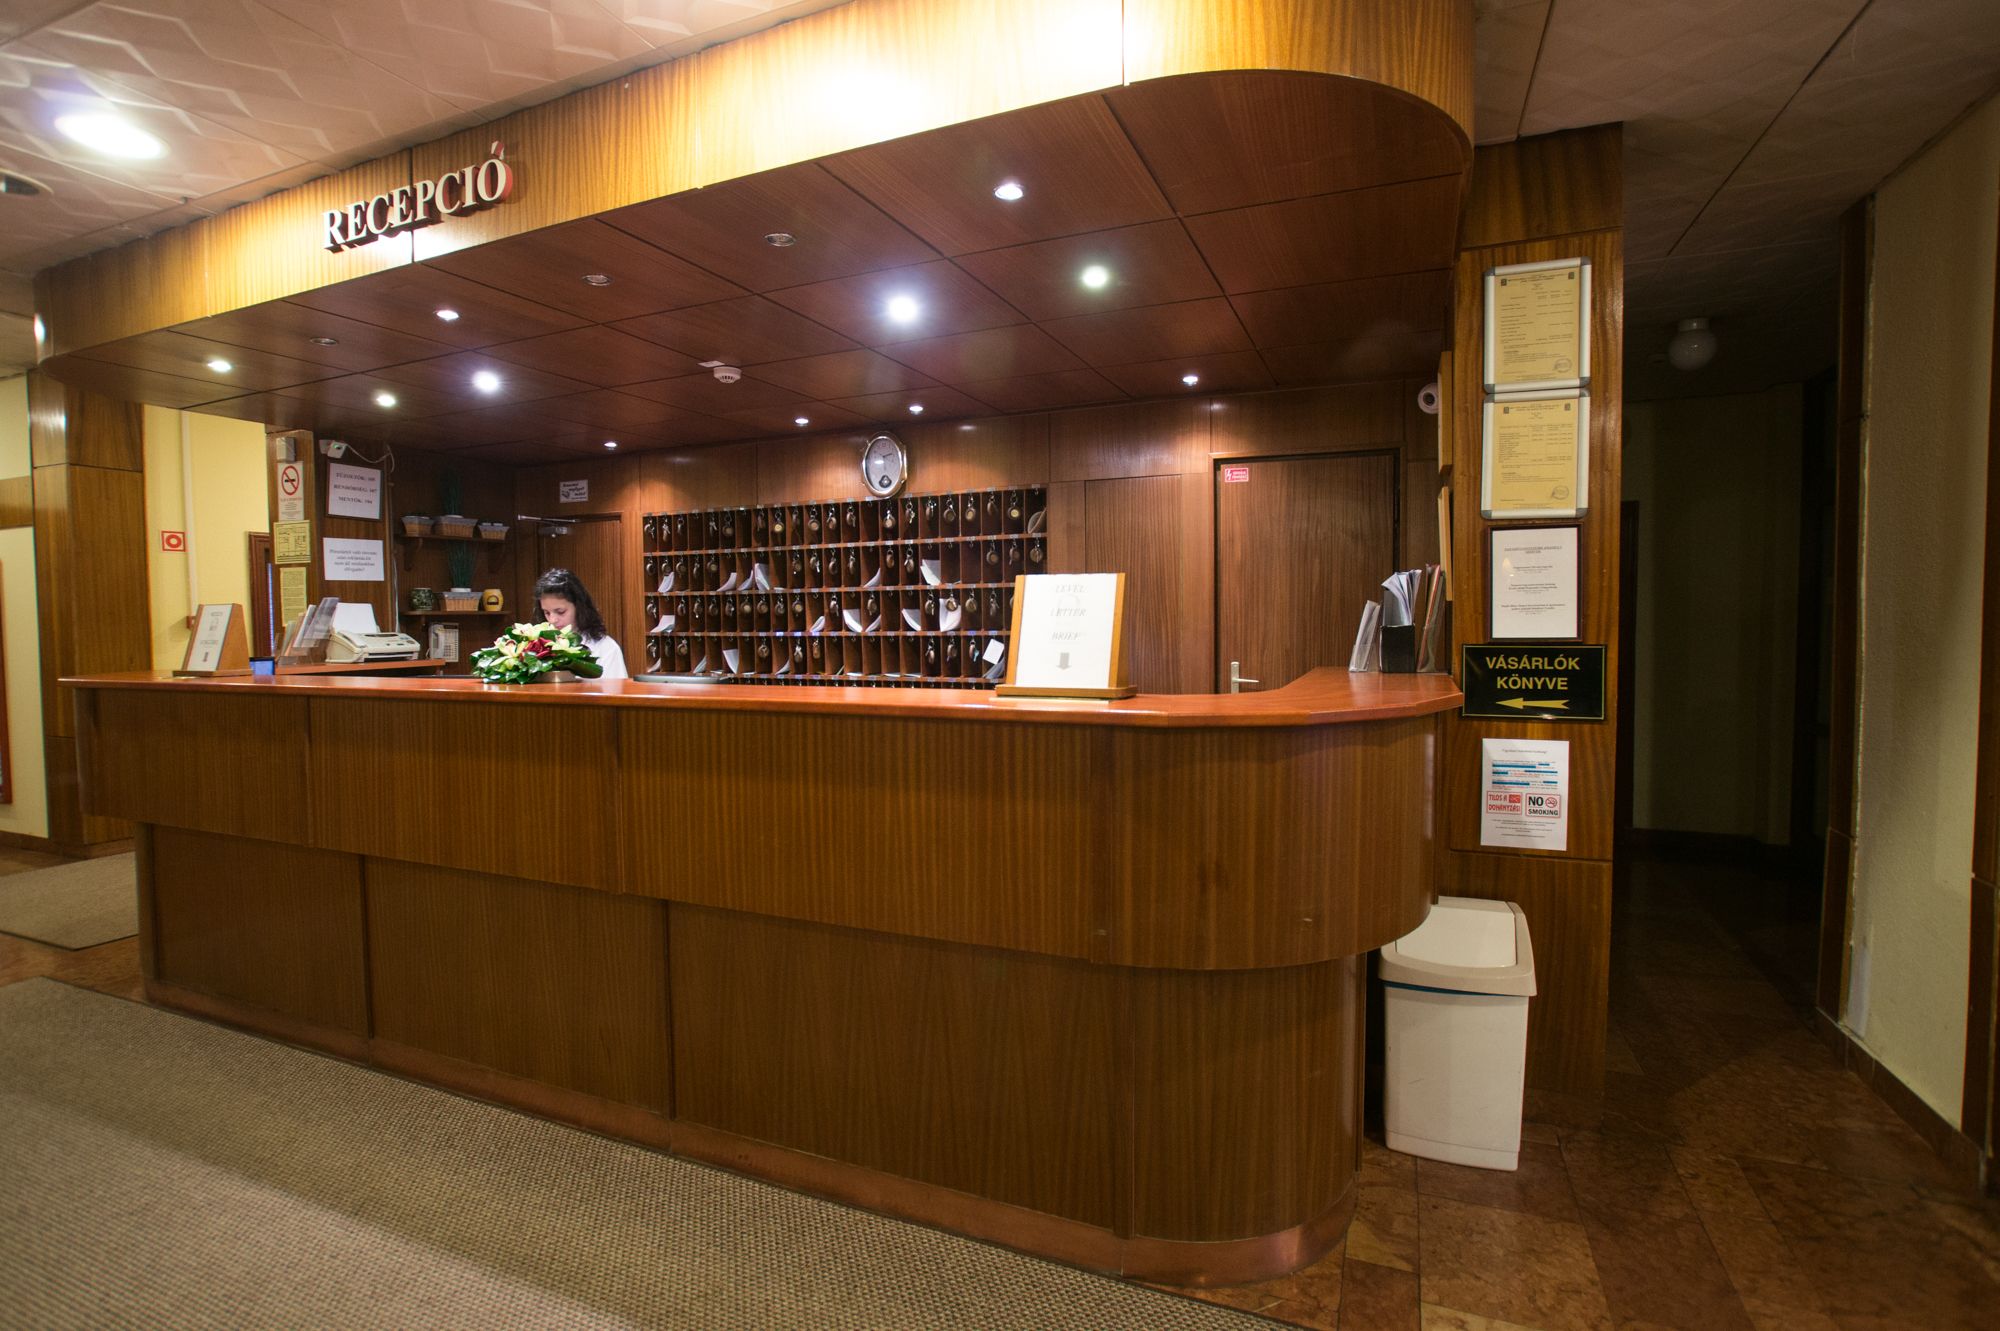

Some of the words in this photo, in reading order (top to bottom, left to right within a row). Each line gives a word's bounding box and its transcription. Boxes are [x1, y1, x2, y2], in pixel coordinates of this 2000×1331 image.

[322, 140, 512, 248] RECEPCIÓ
[1486, 654, 1580, 670] VÁSÁRLÓK
[1496, 674, 1568, 690] KÖNYVE
[1528, 796, 1544, 807] NO
[1528, 808, 1559, 816] SMOKING
